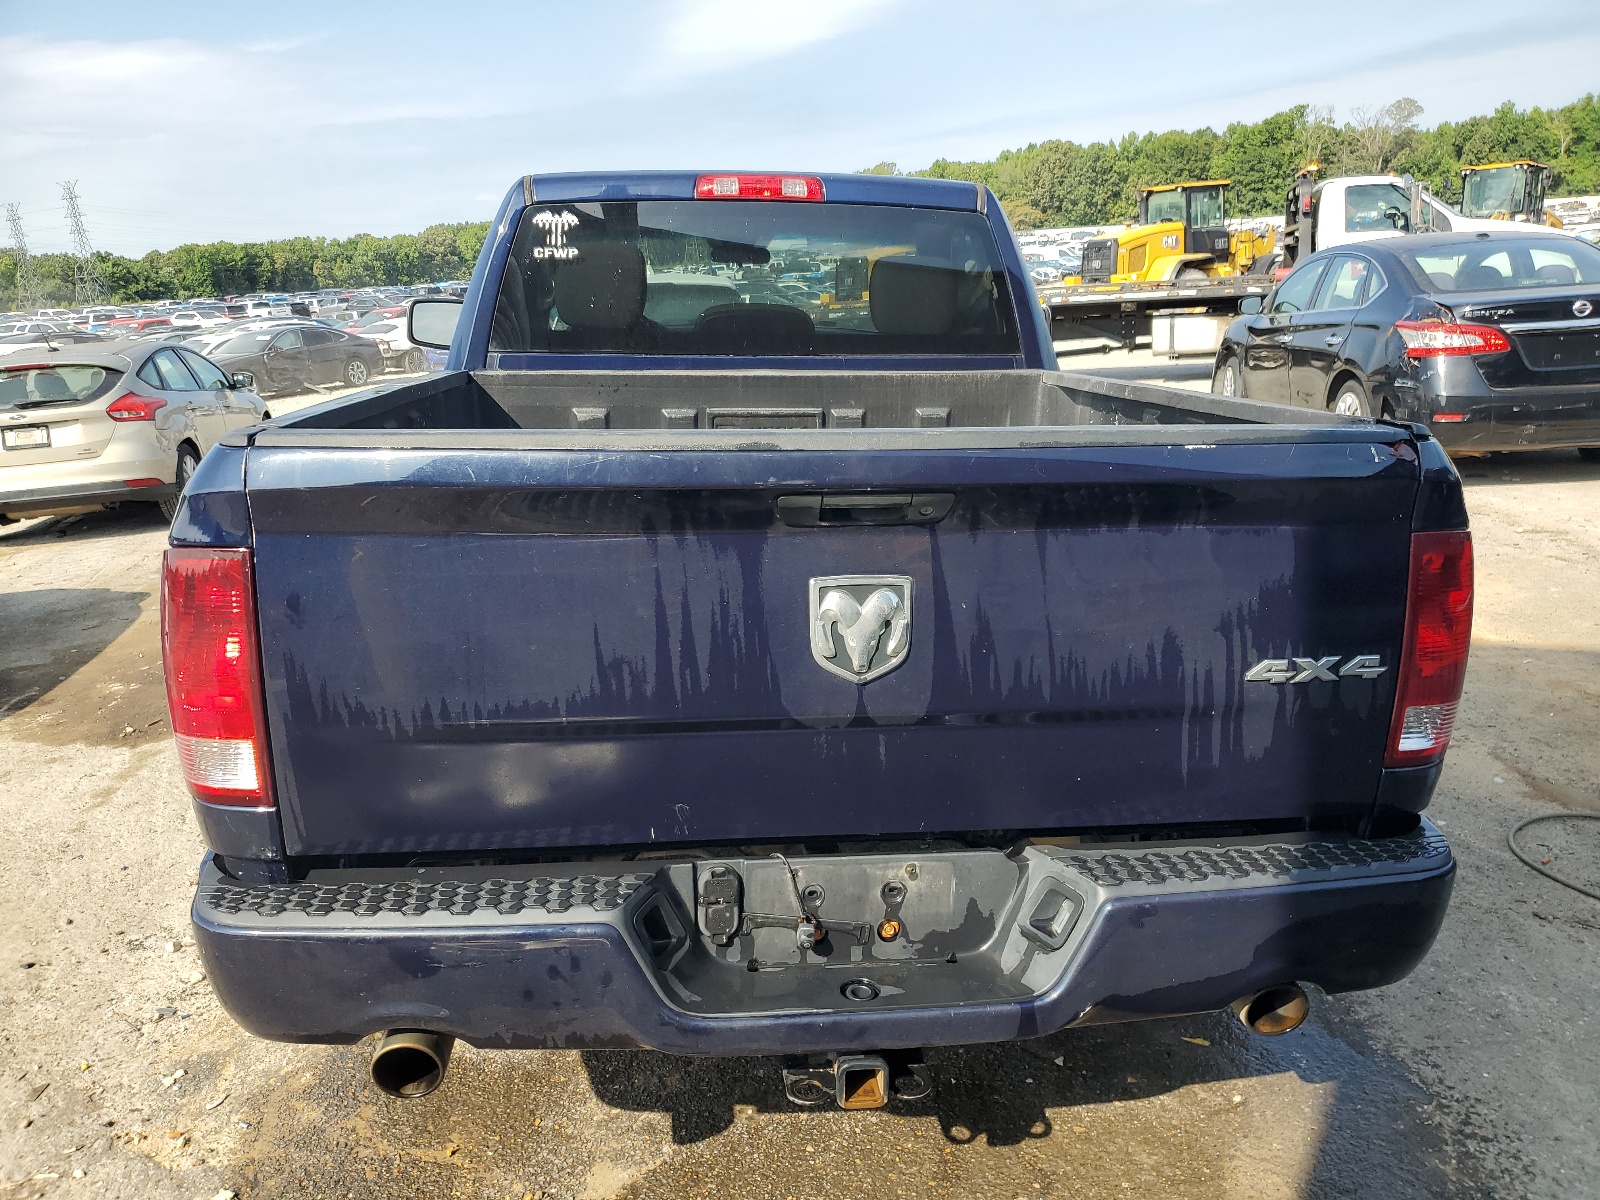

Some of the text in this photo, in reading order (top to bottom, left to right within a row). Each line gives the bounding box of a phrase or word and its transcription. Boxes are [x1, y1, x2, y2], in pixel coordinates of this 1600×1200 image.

[1162, 234, 1177, 249] CAT
[533, 247, 579, 259] CFWP
[1464, 308, 1515, 319] SENTRA
